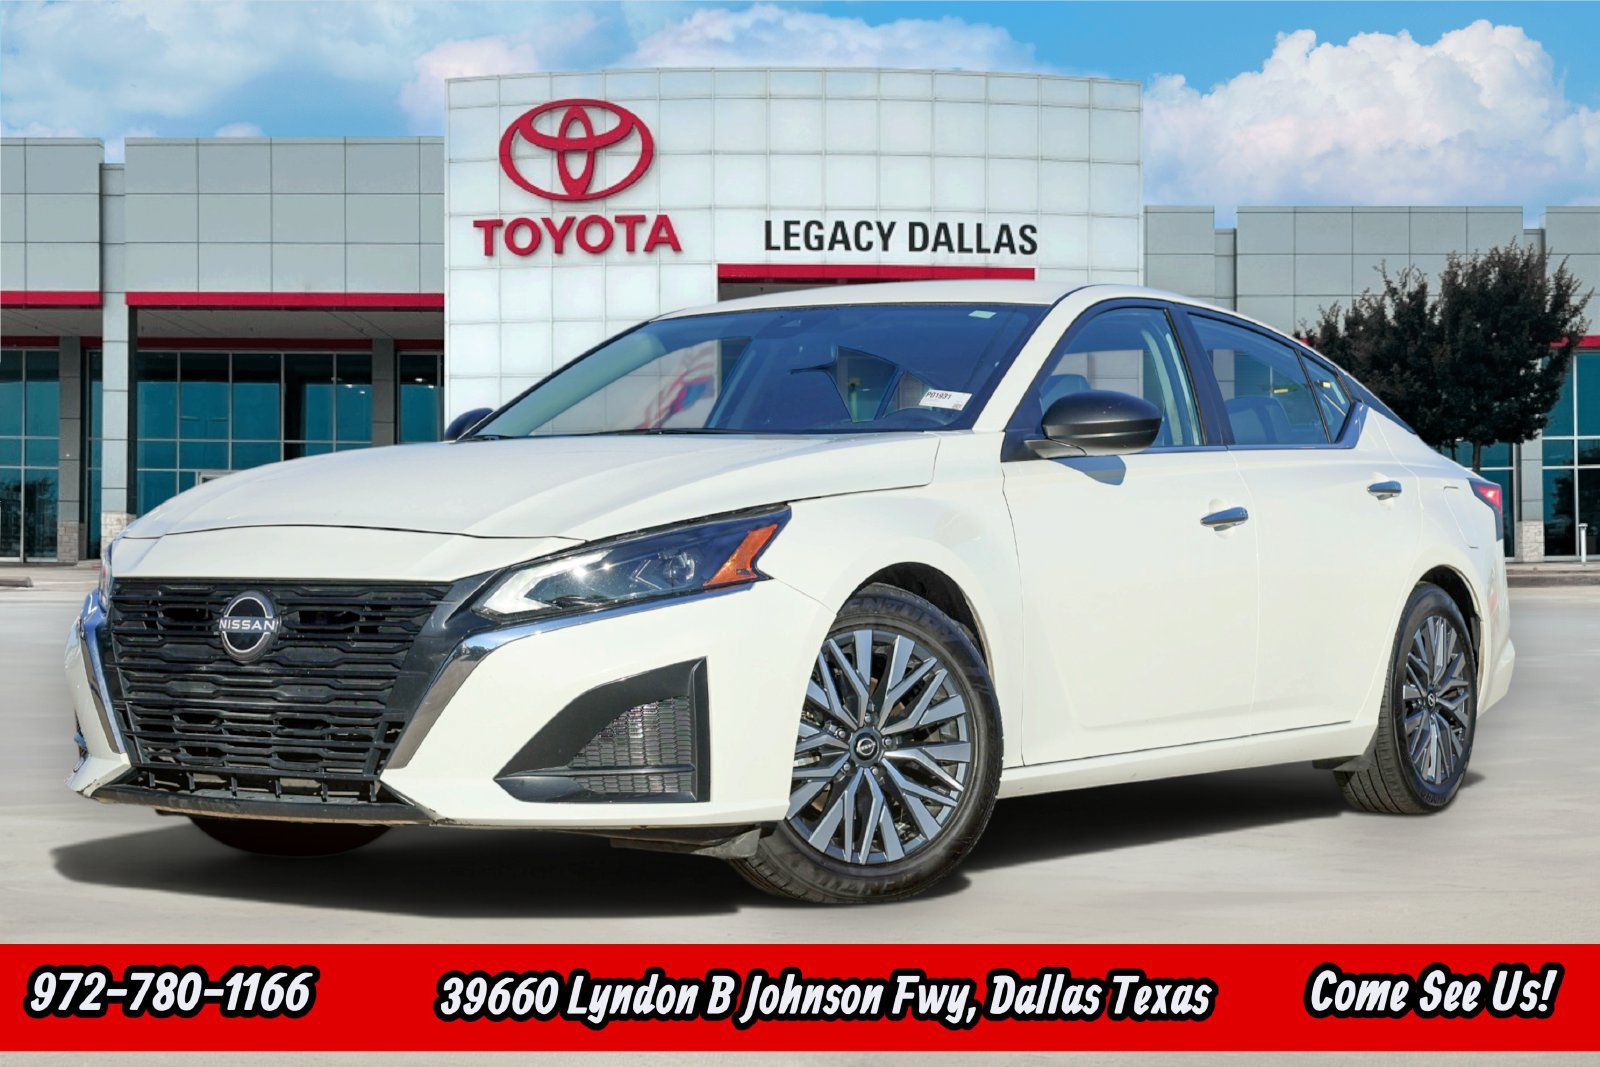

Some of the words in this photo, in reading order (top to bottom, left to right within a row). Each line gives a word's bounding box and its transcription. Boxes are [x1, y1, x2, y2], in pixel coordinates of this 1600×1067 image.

[474, 214, 682, 256] TOYOTA
[764, 220, 897, 253] LEGACY
[908, 221, 1038, 256] DALLAS
[219, 619, 276, 631] NISSAN
